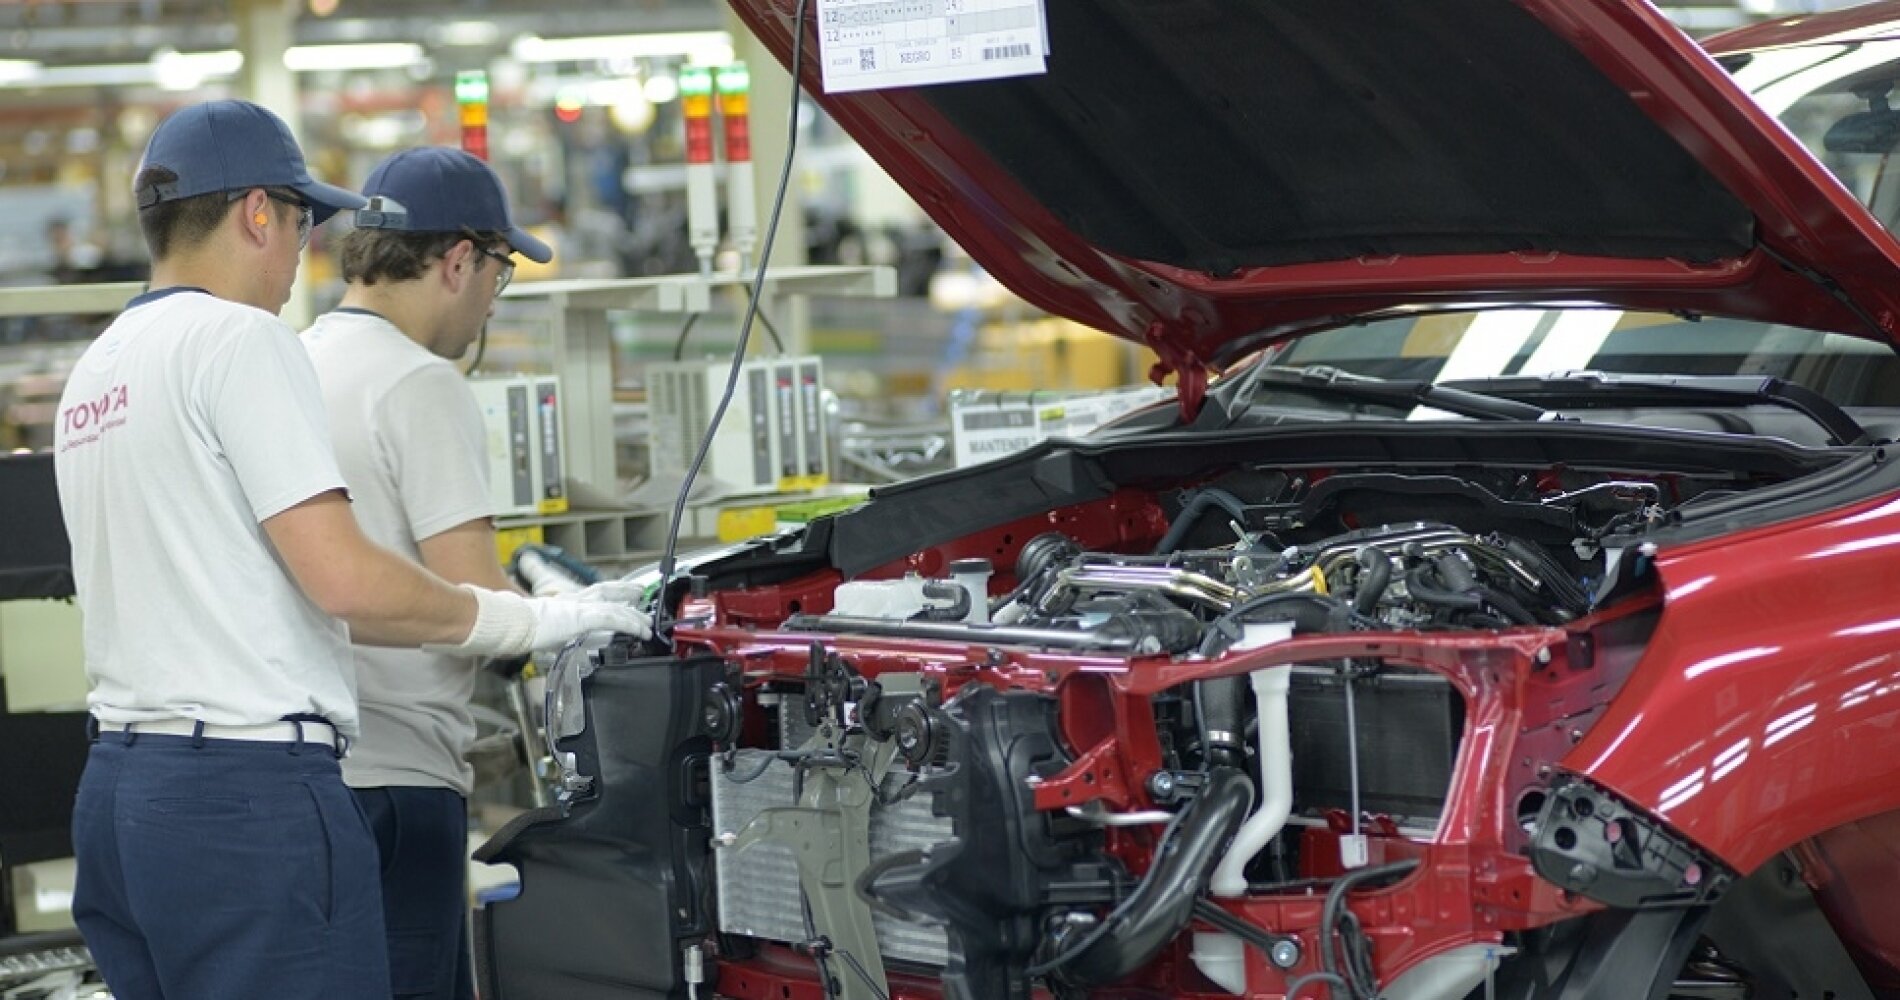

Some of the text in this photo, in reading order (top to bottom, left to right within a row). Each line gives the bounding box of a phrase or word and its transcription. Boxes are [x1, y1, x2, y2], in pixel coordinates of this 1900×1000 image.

[824, 11, 839, 23] 12
[826, 31, 839, 42] 12
[900, 51, 931, 64] NEGRO
[64, 385, 128, 434] TOYOA
